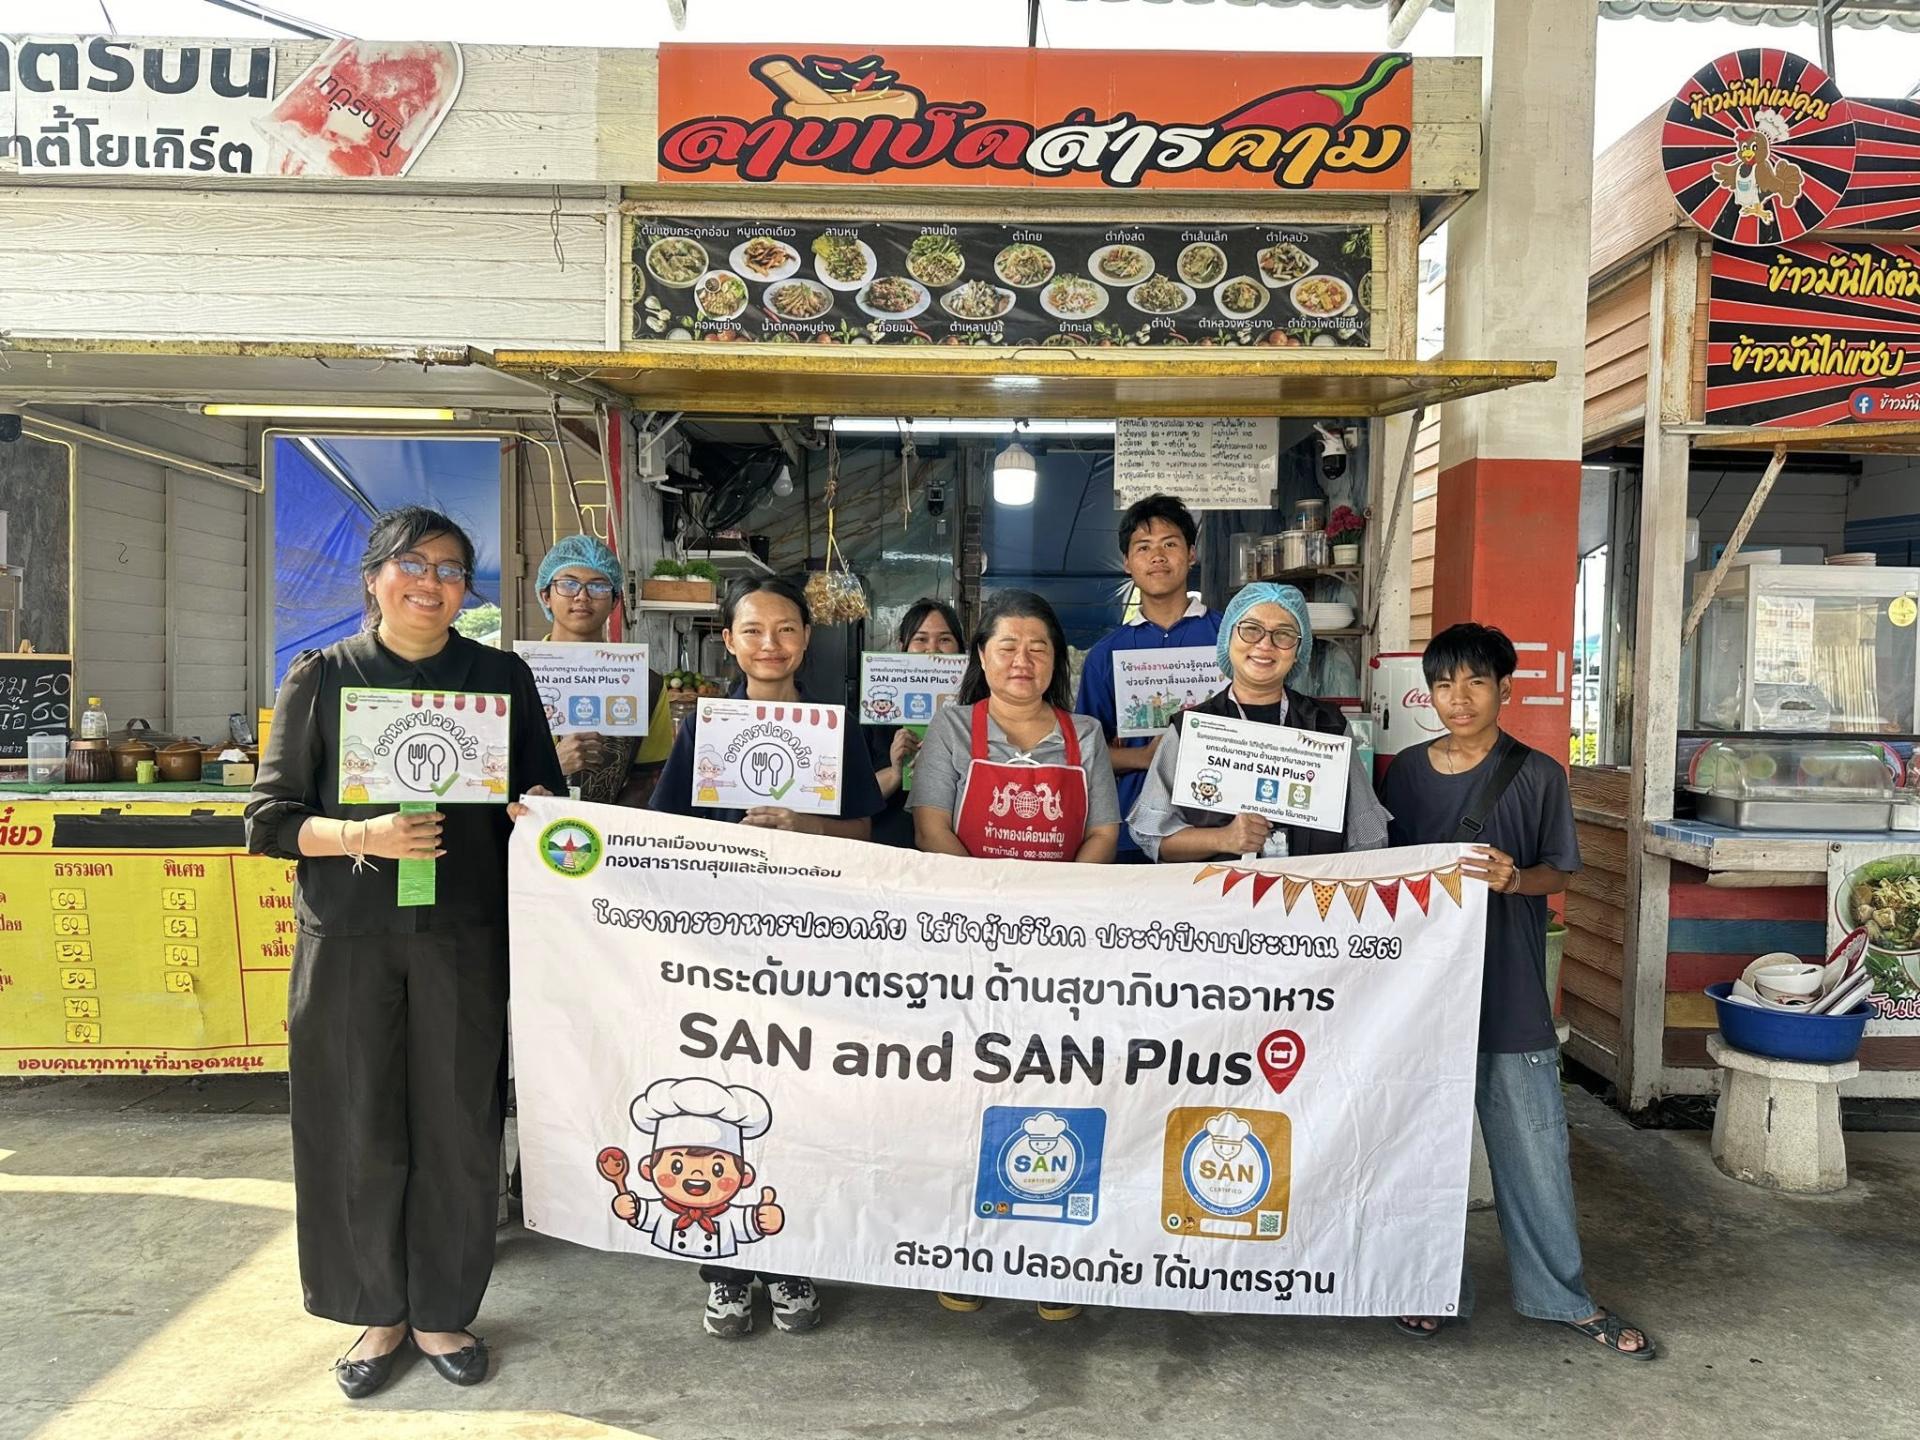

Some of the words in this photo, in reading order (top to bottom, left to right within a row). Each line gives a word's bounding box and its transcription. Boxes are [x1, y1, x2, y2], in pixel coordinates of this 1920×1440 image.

[1121, 659, 1219, 673] ใช้พลังงานอย่างรู้คุณค
[33, 673, 71, 698] 50
[534, 675, 550, 684] AN
[552, 675, 572, 684] and
[574, 675, 595, 684] SAN
[598, 676, 620, 685] Plus
[870, 675, 889, 683] SAN
[891, 675, 908, 683] and
[910, 675, 929, 684] SAN
[931, 676, 949, 684] Plus
[31, 702, 69, 721] 60
[374, 709, 479, 761] อาหารปลอดภัย
[724, 721, 813, 770] อาหารปลอดภัย
[1207, 755, 1230, 769] SAN
[1233, 760, 1253, 772] and
[1256, 763, 1280, 777] SAN
[1282, 767, 1306, 781] Plus
[607, 832, 768, 861] เทศบาลเมืองบางพระ
[54, 861, 113, 878] ธรรมดา
[164, 859, 205, 879] พิเศษ
[605, 852, 842, 879] กองสาธารณสุขและสิ่งแวดล้อม
[592, 897, 907, 941] โครงการอาหารปลอดภัย
[917, 910, 1086, 952] ใส่ใจผู้บริโภค
[1096, 920, 1339, 959] ประจำปีงบประมาณ
[1348, 934, 1402, 961] 2569
[62, 944, 83, 957] 50
[67, 972, 86, 984] 50
[660, 955, 974, 1009] ยกระดับมาตรฐาน
[985, 961, 1335, 1022] ด้านสุขาภิบาลอาหาร
[18, 1050, 264, 1072] ขอบคุณทุกท่านที่มาอุดหนุน
[679, 1011, 812, 1072] SAN
[832, 1031, 954, 1083] and
[973, 1032, 1105, 1087] SAN
[1124, 1037, 1253, 1087] Plus
[1014, 1154, 1067, 1174] SAN
[1199, 1159, 1255, 1183] SAN
[893, 1240, 993, 1273] สะอาด
[1003, 1244, 1143, 1286] ปลอดภัย
[1153, 1253, 1336, 1301] ได้มาตรฐาน
